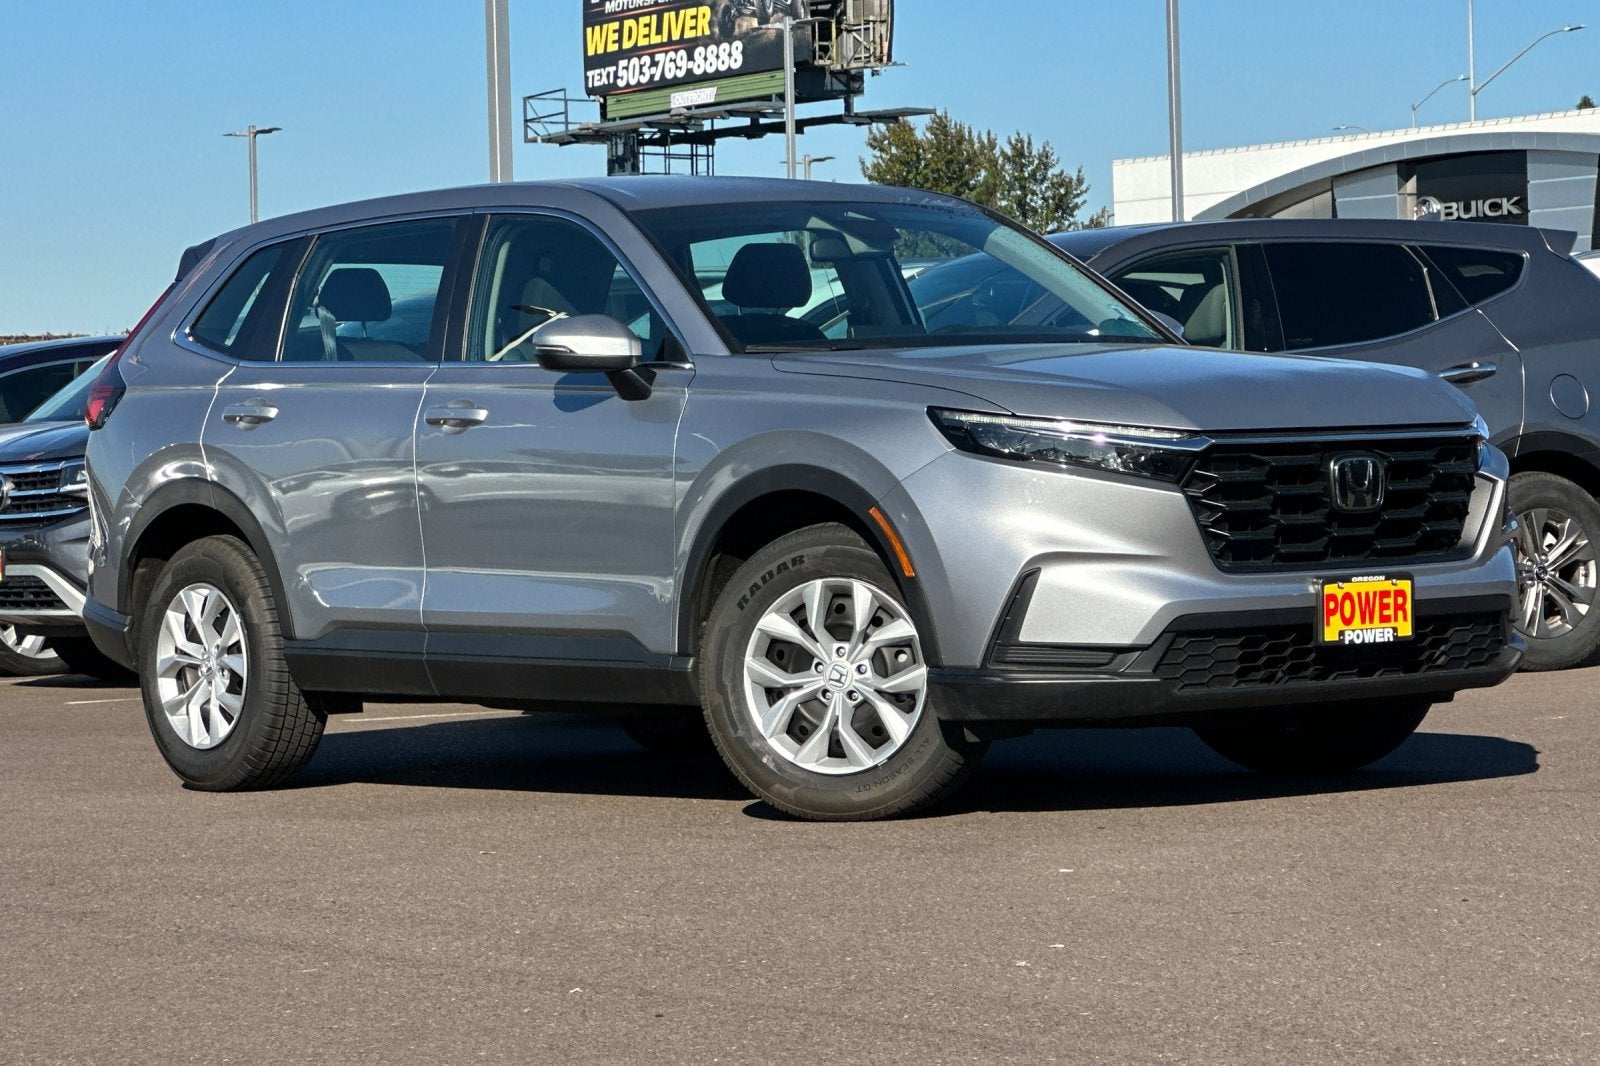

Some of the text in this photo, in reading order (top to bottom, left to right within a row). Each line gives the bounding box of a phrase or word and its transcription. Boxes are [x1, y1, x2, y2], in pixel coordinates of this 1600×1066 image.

[586, 5, 711, 56] WE DELIVER
[587, 40, 743, 88] TEXT 503-769-8888
[1441, 196, 1522, 221] BUICK
[737, 554, 806, 611] RADAR
[1325, 588, 1408, 627] POWER
[1344, 628, 1394, 645] POWER
[856, 784, 871, 793] GT
[873, 756, 915, 788] SEASON
